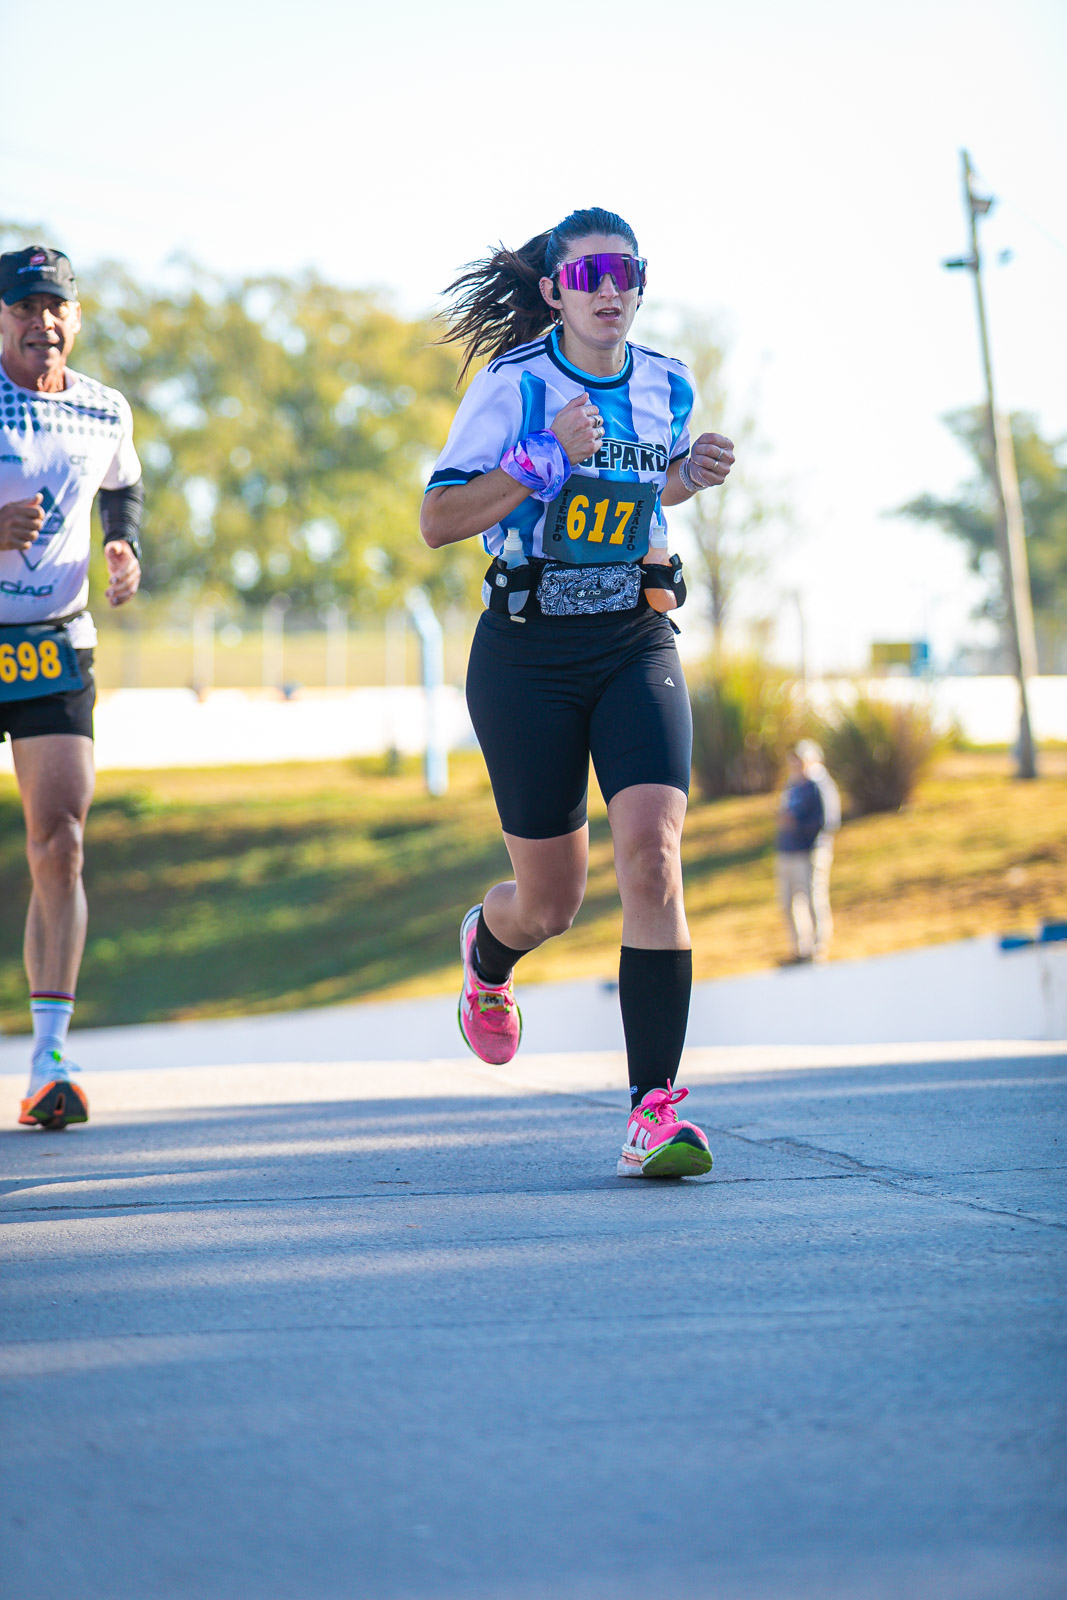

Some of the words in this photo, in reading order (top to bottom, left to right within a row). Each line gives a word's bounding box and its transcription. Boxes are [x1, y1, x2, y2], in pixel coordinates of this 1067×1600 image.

[552, 488, 572, 542] TIEMPO
[566, 494, 636, 545] 617
[626, 500, 645, 551] EXACTO
[0, 639, 63, 684] 698
